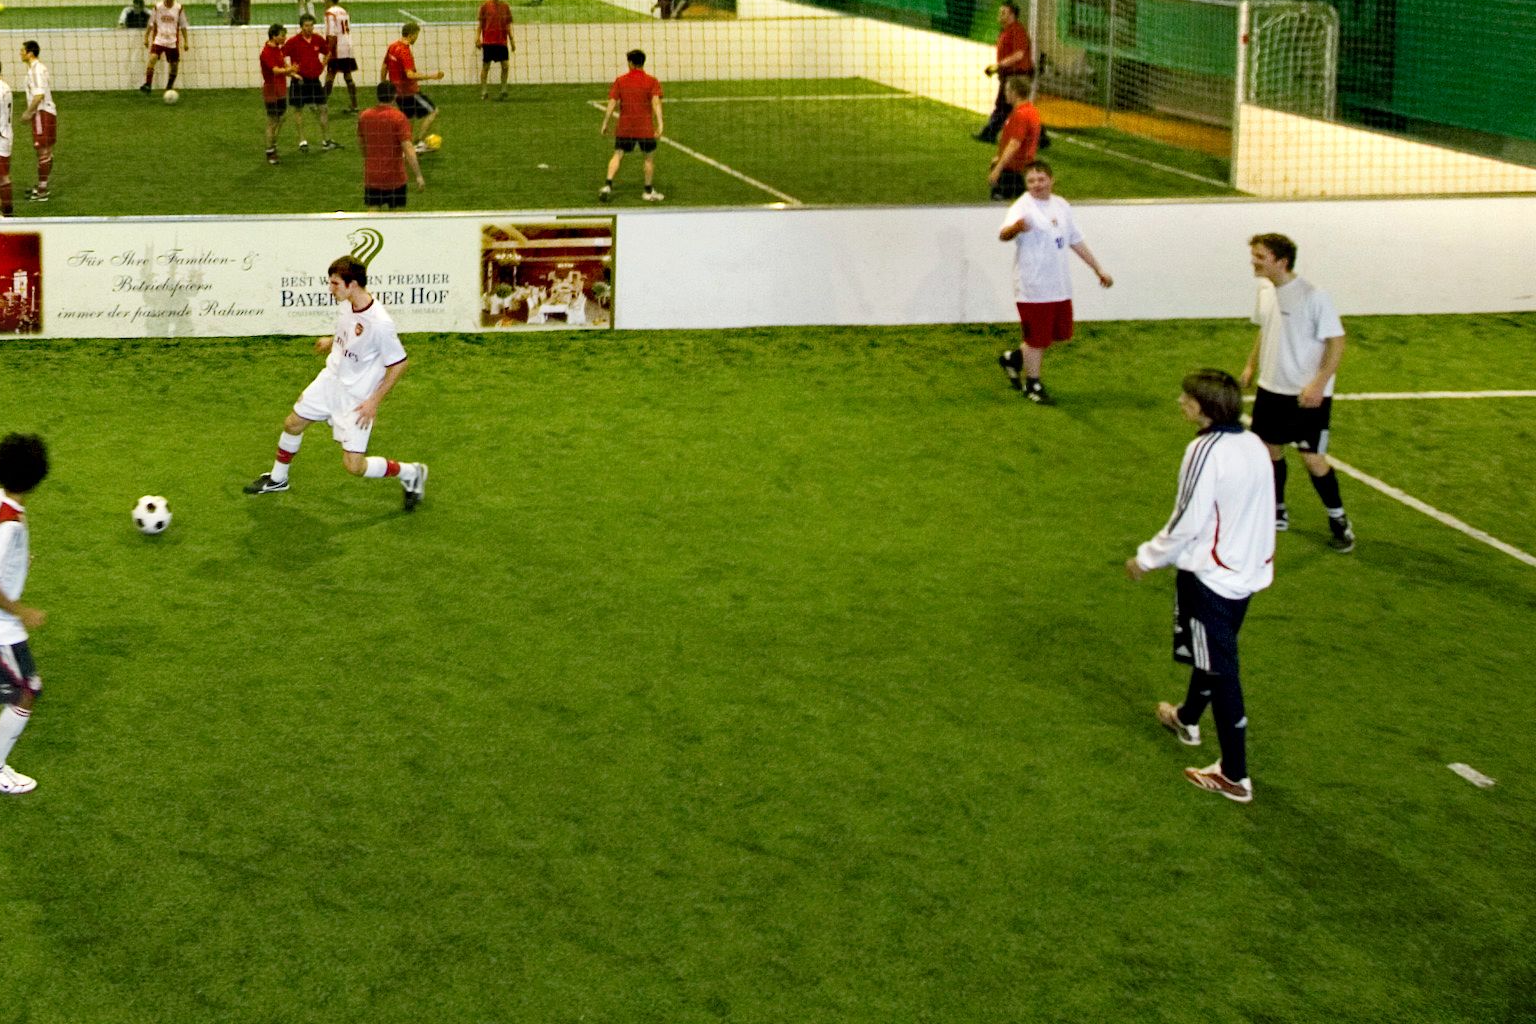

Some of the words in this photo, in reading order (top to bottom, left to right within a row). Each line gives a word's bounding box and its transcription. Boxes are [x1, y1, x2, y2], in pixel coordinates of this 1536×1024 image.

[67, 250, 104, 267] Für
[110, 250, 149, 266] Ihre
[157, 249, 237, 266] Familien-
[112, 275, 214, 297] Betriebsfeiern
[281, 276, 314, 287] BEST
[388, 273, 450, 285] PREMIER
[281, 290, 404, 307] BAYERER
[410, 287, 450, 304] HOF
[57, 307, 103, 319] immer
[107, 304, 128, 318] der
[130, 304, 192, 323] passende
[198, 300, 265, 317] Rahmen
